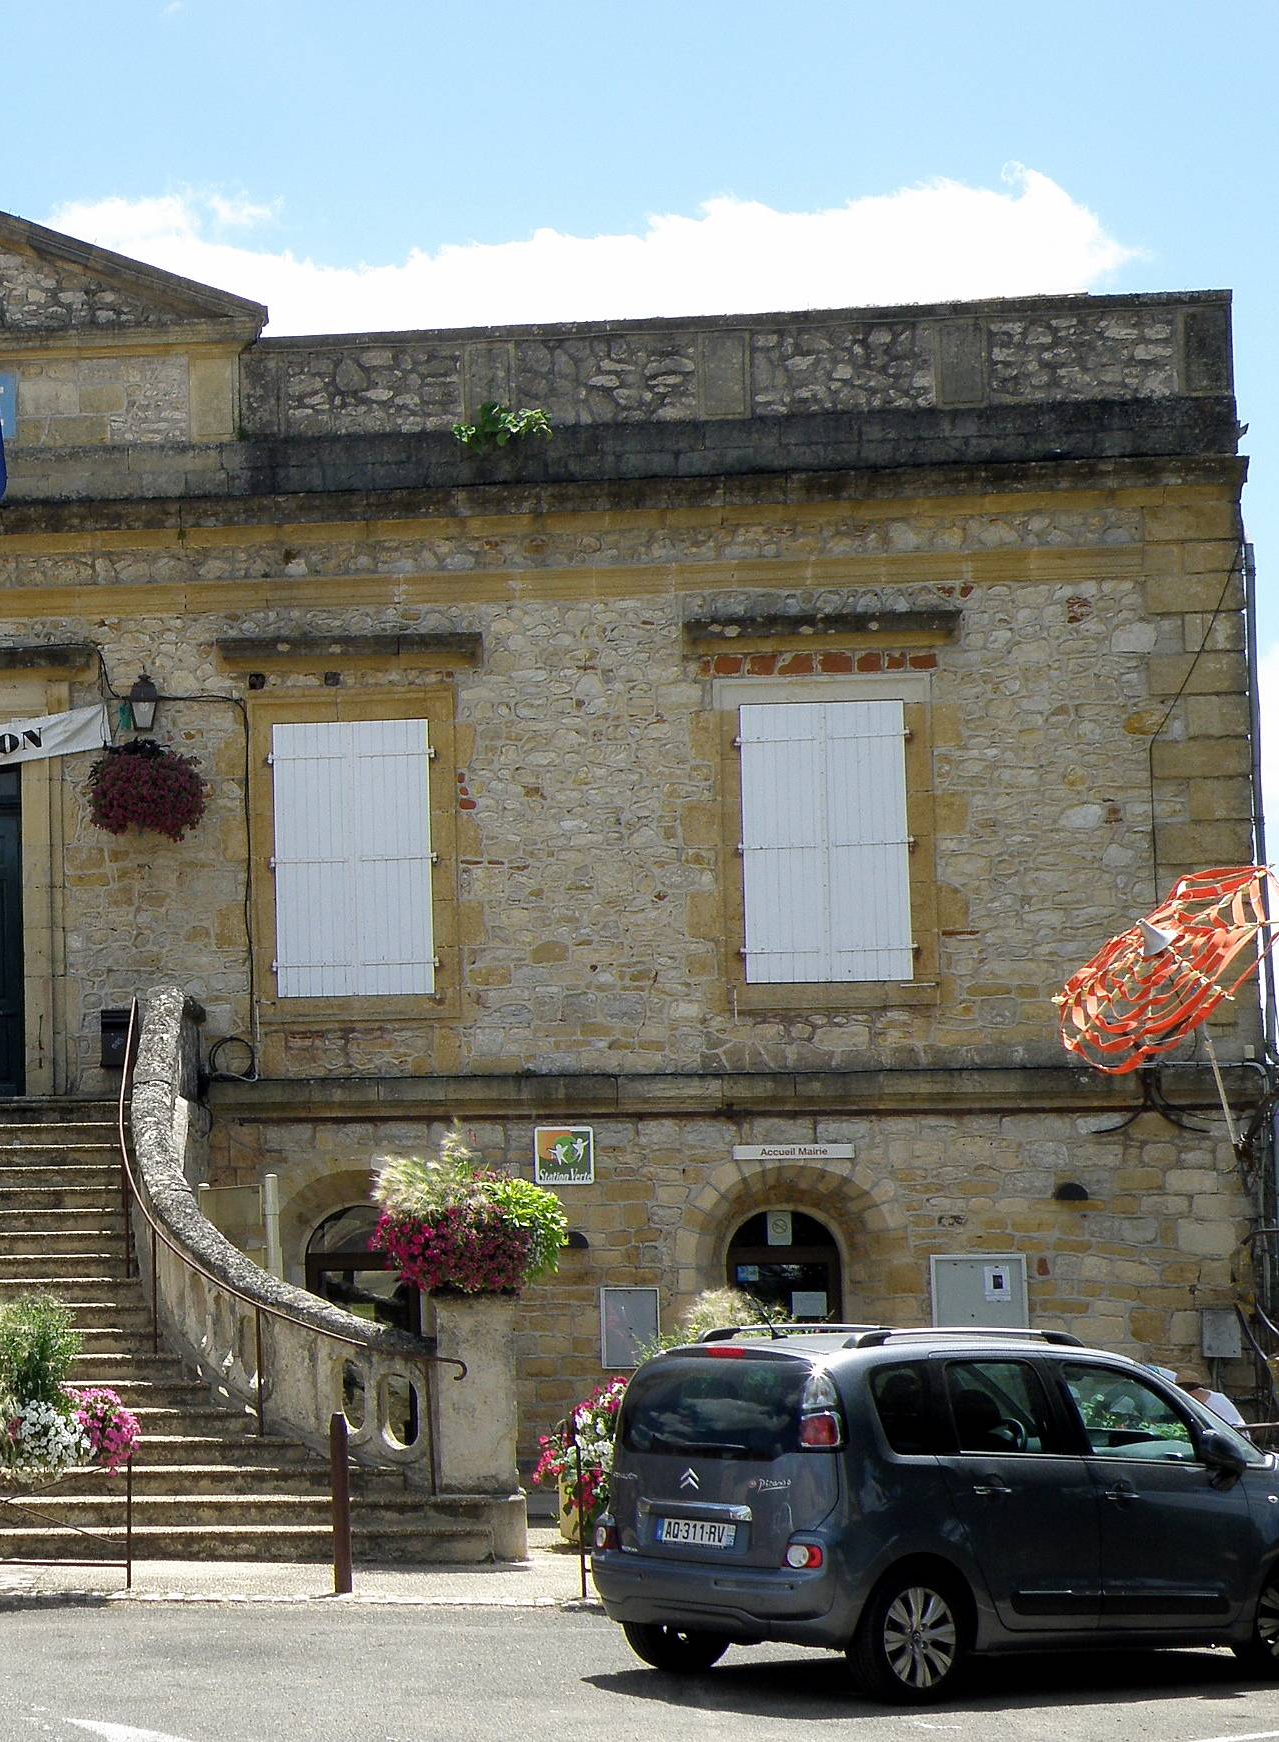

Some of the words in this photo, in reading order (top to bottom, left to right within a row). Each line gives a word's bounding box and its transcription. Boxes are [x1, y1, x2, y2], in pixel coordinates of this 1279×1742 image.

[760, 1147, 795, 1156] Accueil
[798, 1146, 828, 1156] Mairie
[539, 1168, 569, 1182] Station
[569, 1167, 592, 1182] Verte
[664, 1520, 726, 1543] AQ-311-RV
